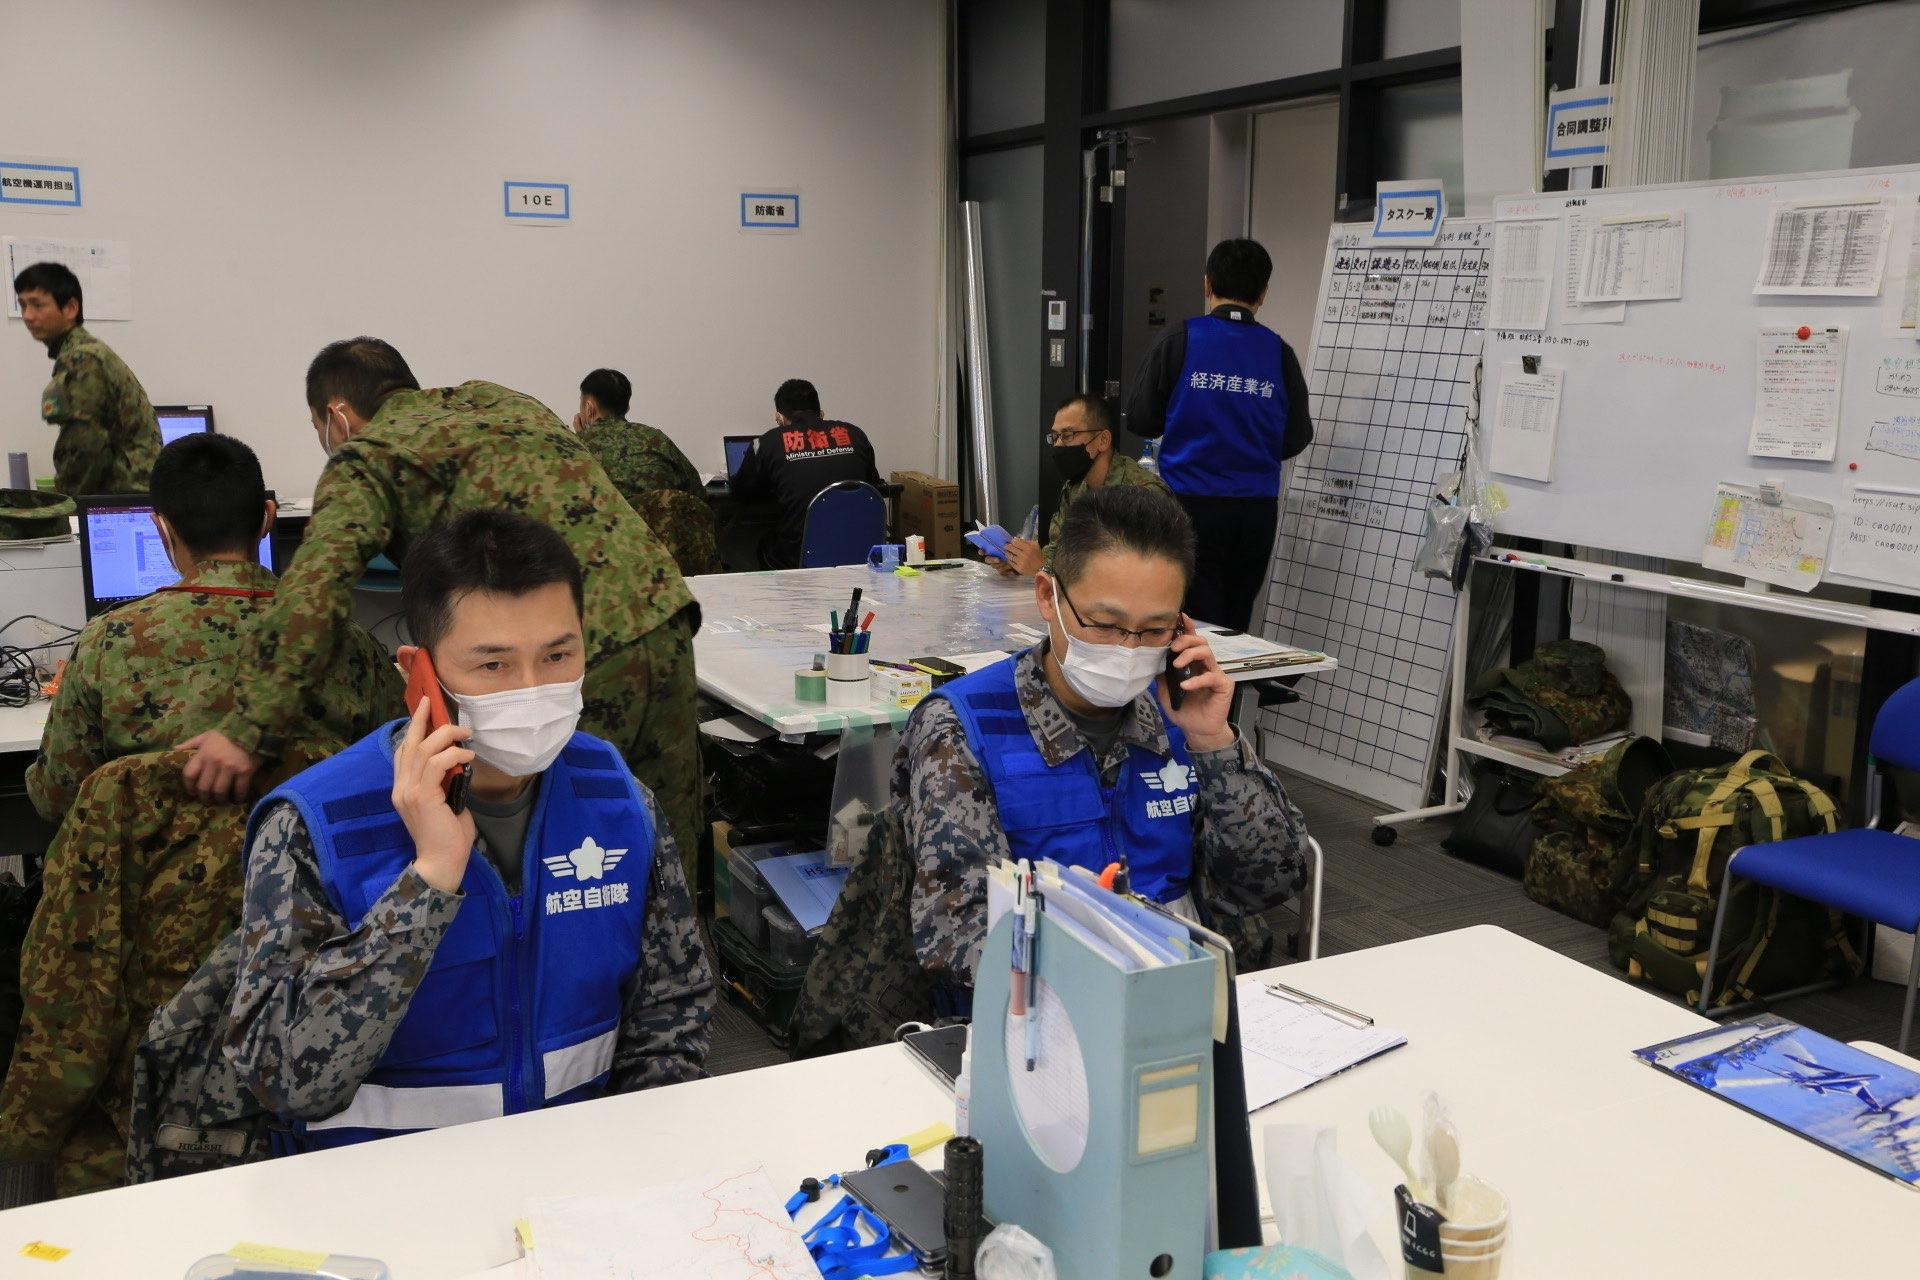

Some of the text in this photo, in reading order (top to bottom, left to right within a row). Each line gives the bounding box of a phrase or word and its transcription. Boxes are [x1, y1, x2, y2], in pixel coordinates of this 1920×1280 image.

[1, 177, 73, 191] 航空機運用担当
[522, 194, 552, 206] 10E
[755, 205, 785, 216] 防衛省
[1387, 207, 1434, 221] タスク一覧
[1190, 371, 1275, 399] 経済産業省
[782, 426, 852, 453] 防衛省
[785, 451, 816, 461] Ministry
[826, 446, 855, 455] Defense
